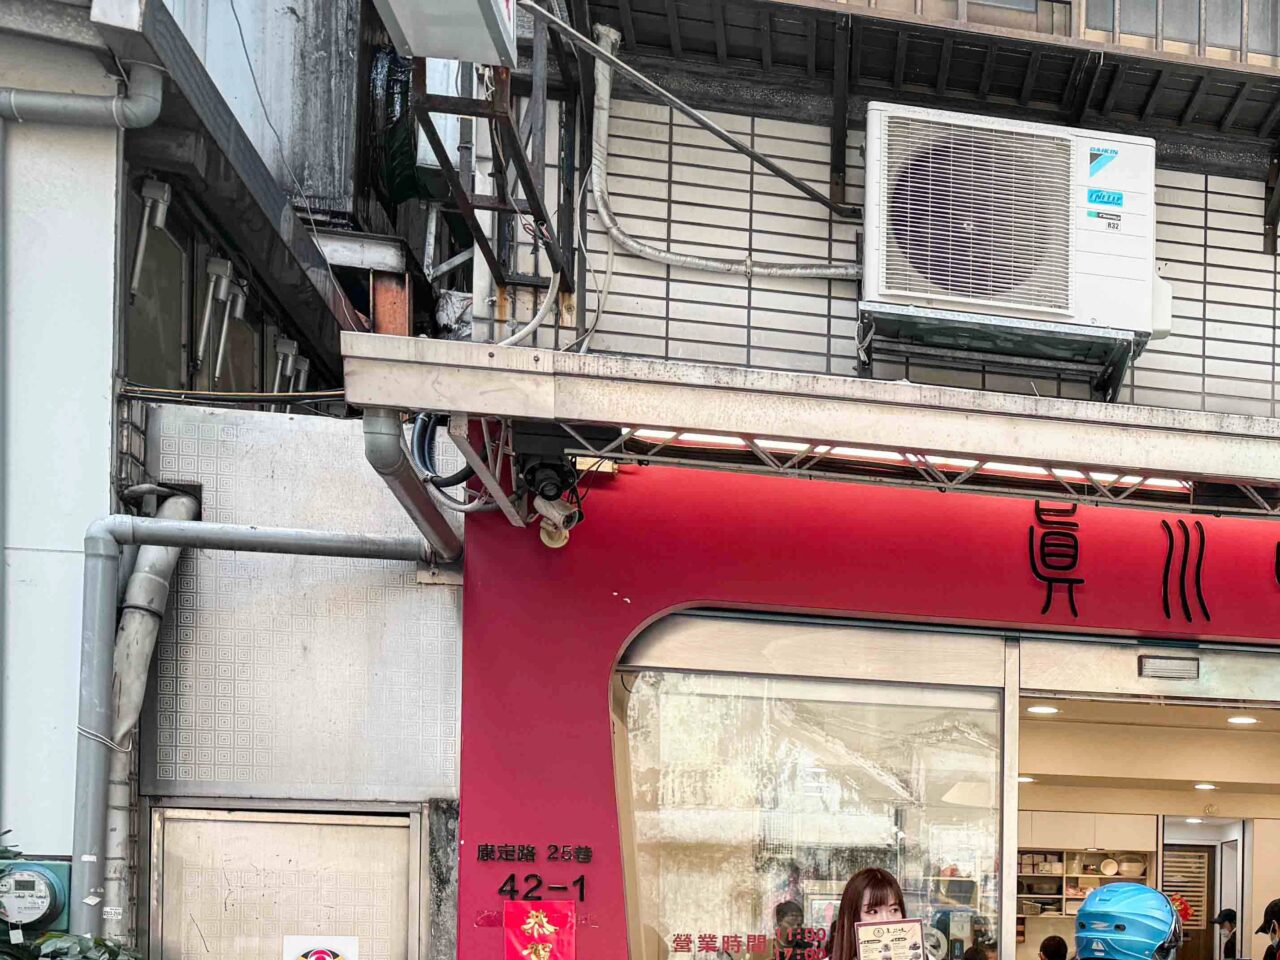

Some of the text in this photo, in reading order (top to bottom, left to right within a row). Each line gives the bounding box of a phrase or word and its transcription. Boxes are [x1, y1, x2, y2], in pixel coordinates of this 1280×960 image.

[1107, 221, 1119, 230] R32
[477, 843, 592, 863] 康定路 25巷
[498, 873, 585, 902] 42-1
[673, 933, 767, 953] 營業時間
[774, 928, 827, 942] 11:00
